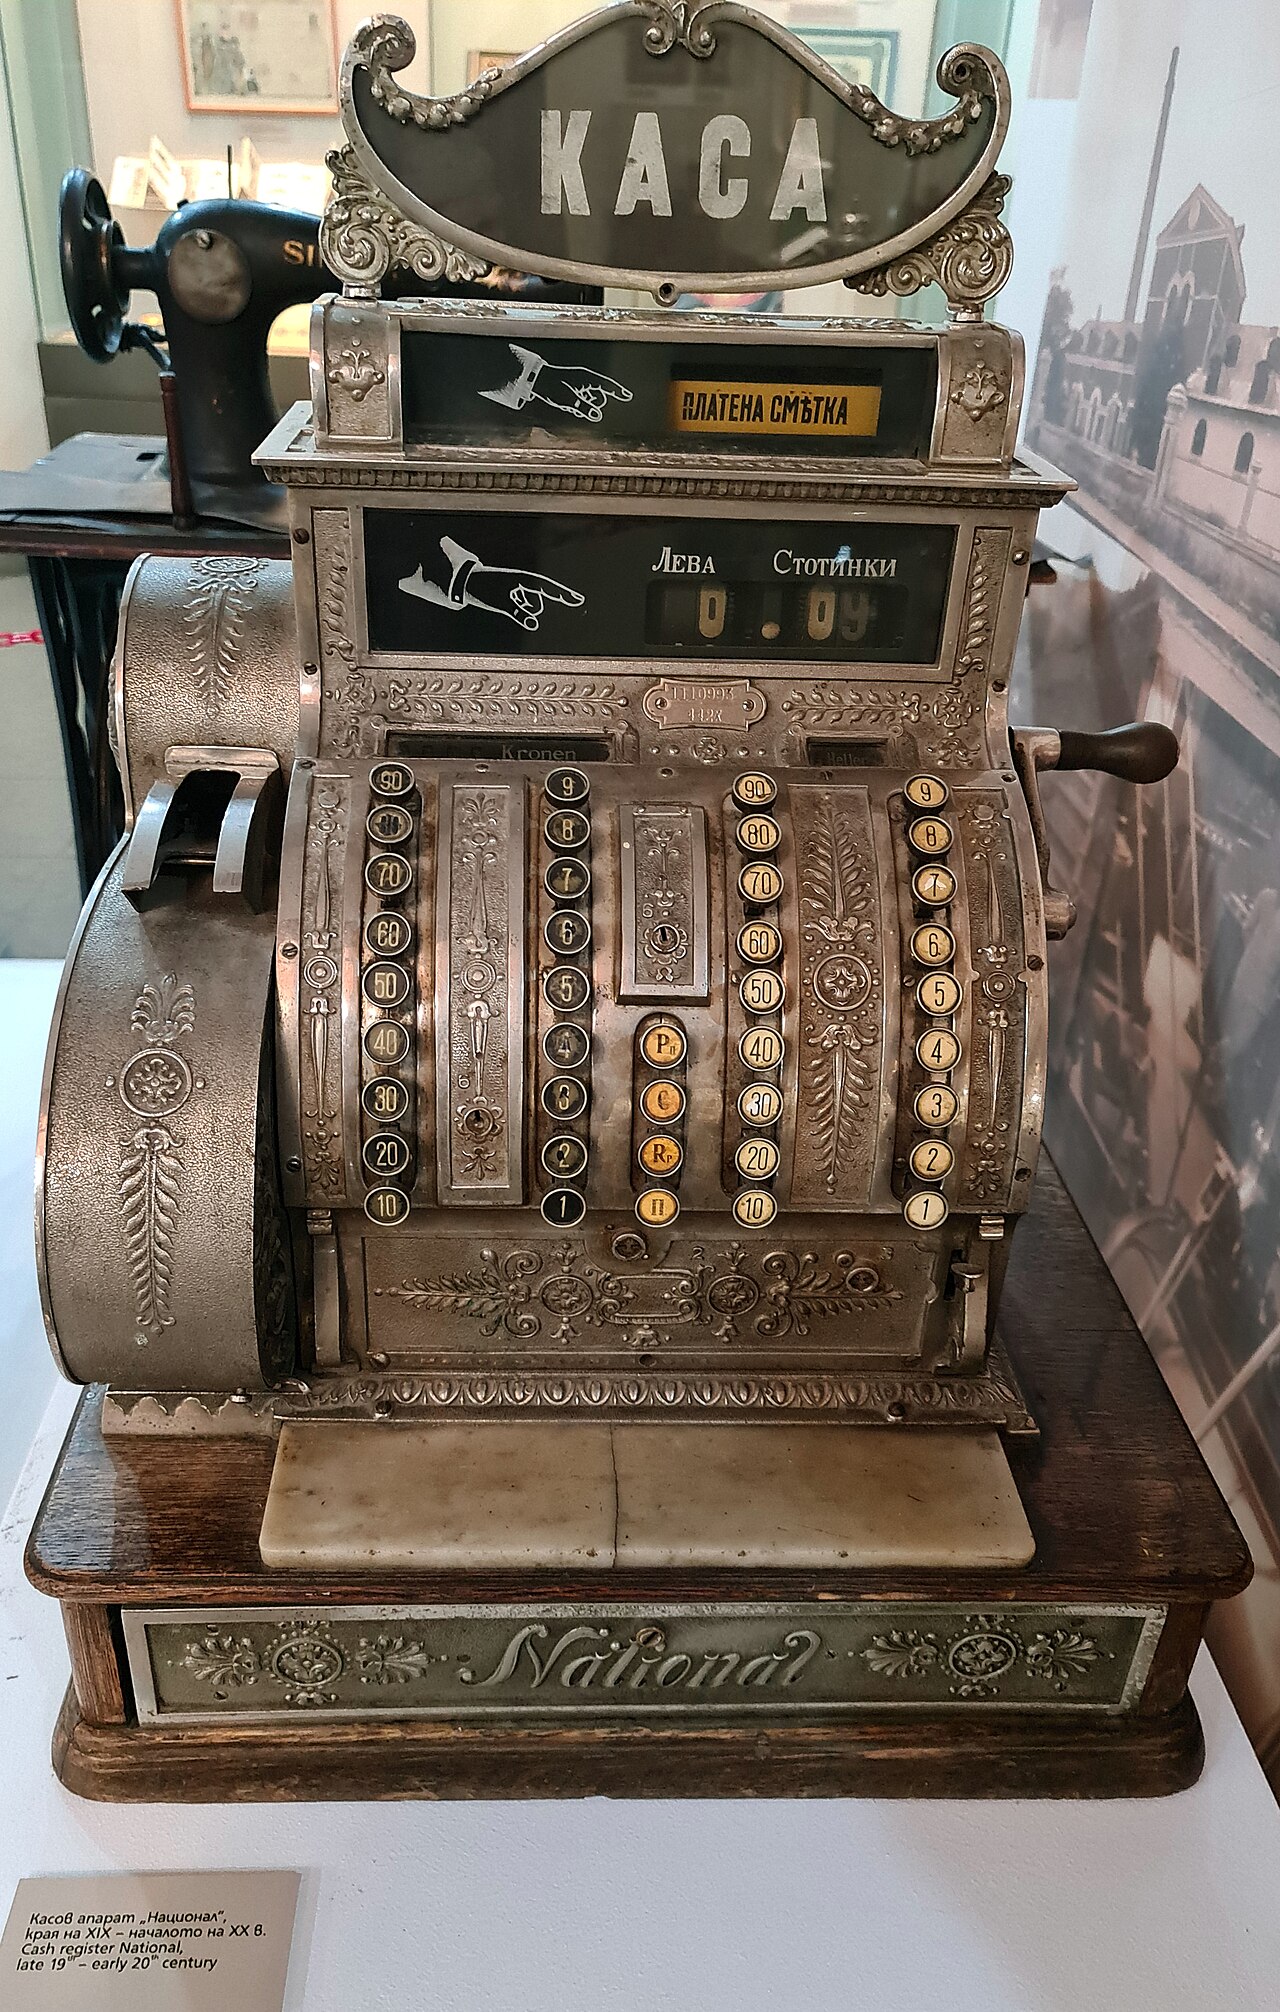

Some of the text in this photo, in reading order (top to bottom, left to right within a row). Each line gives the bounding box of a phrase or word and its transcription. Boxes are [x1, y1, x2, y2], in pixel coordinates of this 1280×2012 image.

[540, 109, 828, 222] КАСА
[682, 391, 764, 423] ПЛАТЕНА
[501, 744, 577, 760] Kronen
[379, 770, 403, 791] 90
[562, 776, 574, 796] 9
[744, 780, 765, 799] 90
[920, 782, 932, 802] 9
[562, 818, 573, 841] 8
[748, 823, 770, 845] 80
[926, 825, 937, 847] 8
[377, 862, 401, 888] 70
[561, 867, 573, 892] 7
[750, 871, 772, 895] 70
[929, 873, 940, 898] 7
[377, 921, 400, 947] 60
[562, 919, 573, 946] 6
[750, 930, 770, 955] 60
[928, 932, 940, 958] 6
[374, 972, 398, 999] 50
[561, 974, 573, 1001] 5
[751, 979, 772, 1004] 50
[933, 981, 945, 1007] 5
[373, 1029, 398, 1056] 40
[557, 1031, 571, 1059] 4
[749, 1036, 773, 1062] 40
[930, 1038, 943, 1064] 4
[374, 1085, 398, 1112] 30
[557, 1084, 570, 1110] 3
[750, 1092, 772, 1118] 30
[931, 1092, 942, 1118] 3
[376, 1141, 399, 1167] 20
[558, 1143, 571, 1168] 2
[746, 1146, 769, 1171] 20
[926, 1147, 940, 1172] 2
[376, 1194, 397, 1217] 10
[559, 1195, 567, 1218] 1
[745, 1197, 764, 1220] 10
[922, 1198, 930, 1221] 1
[460, 1624, 821, 1690] National
[30, 1912, 74, 1925] Касов
[77, 1914, 135, 1927] апарат
[25, 1927, 60, 1943] края
[63, 1930, 81, 1940] на
[85, 1926, 112, 1940] XIX
[128, 1927, 203, 1939] началото
[207, 1927, 224, 1938] на
[228, 1924, 250, 1937] XX
[254, 1924, 267, 1937] в.
[21, 1940, 184, 1957] Cash register National,
[16, 1957, 44, 1971] late
[91, 1956, 128, 1973] early
[162, 1957, 218, 1972] century
